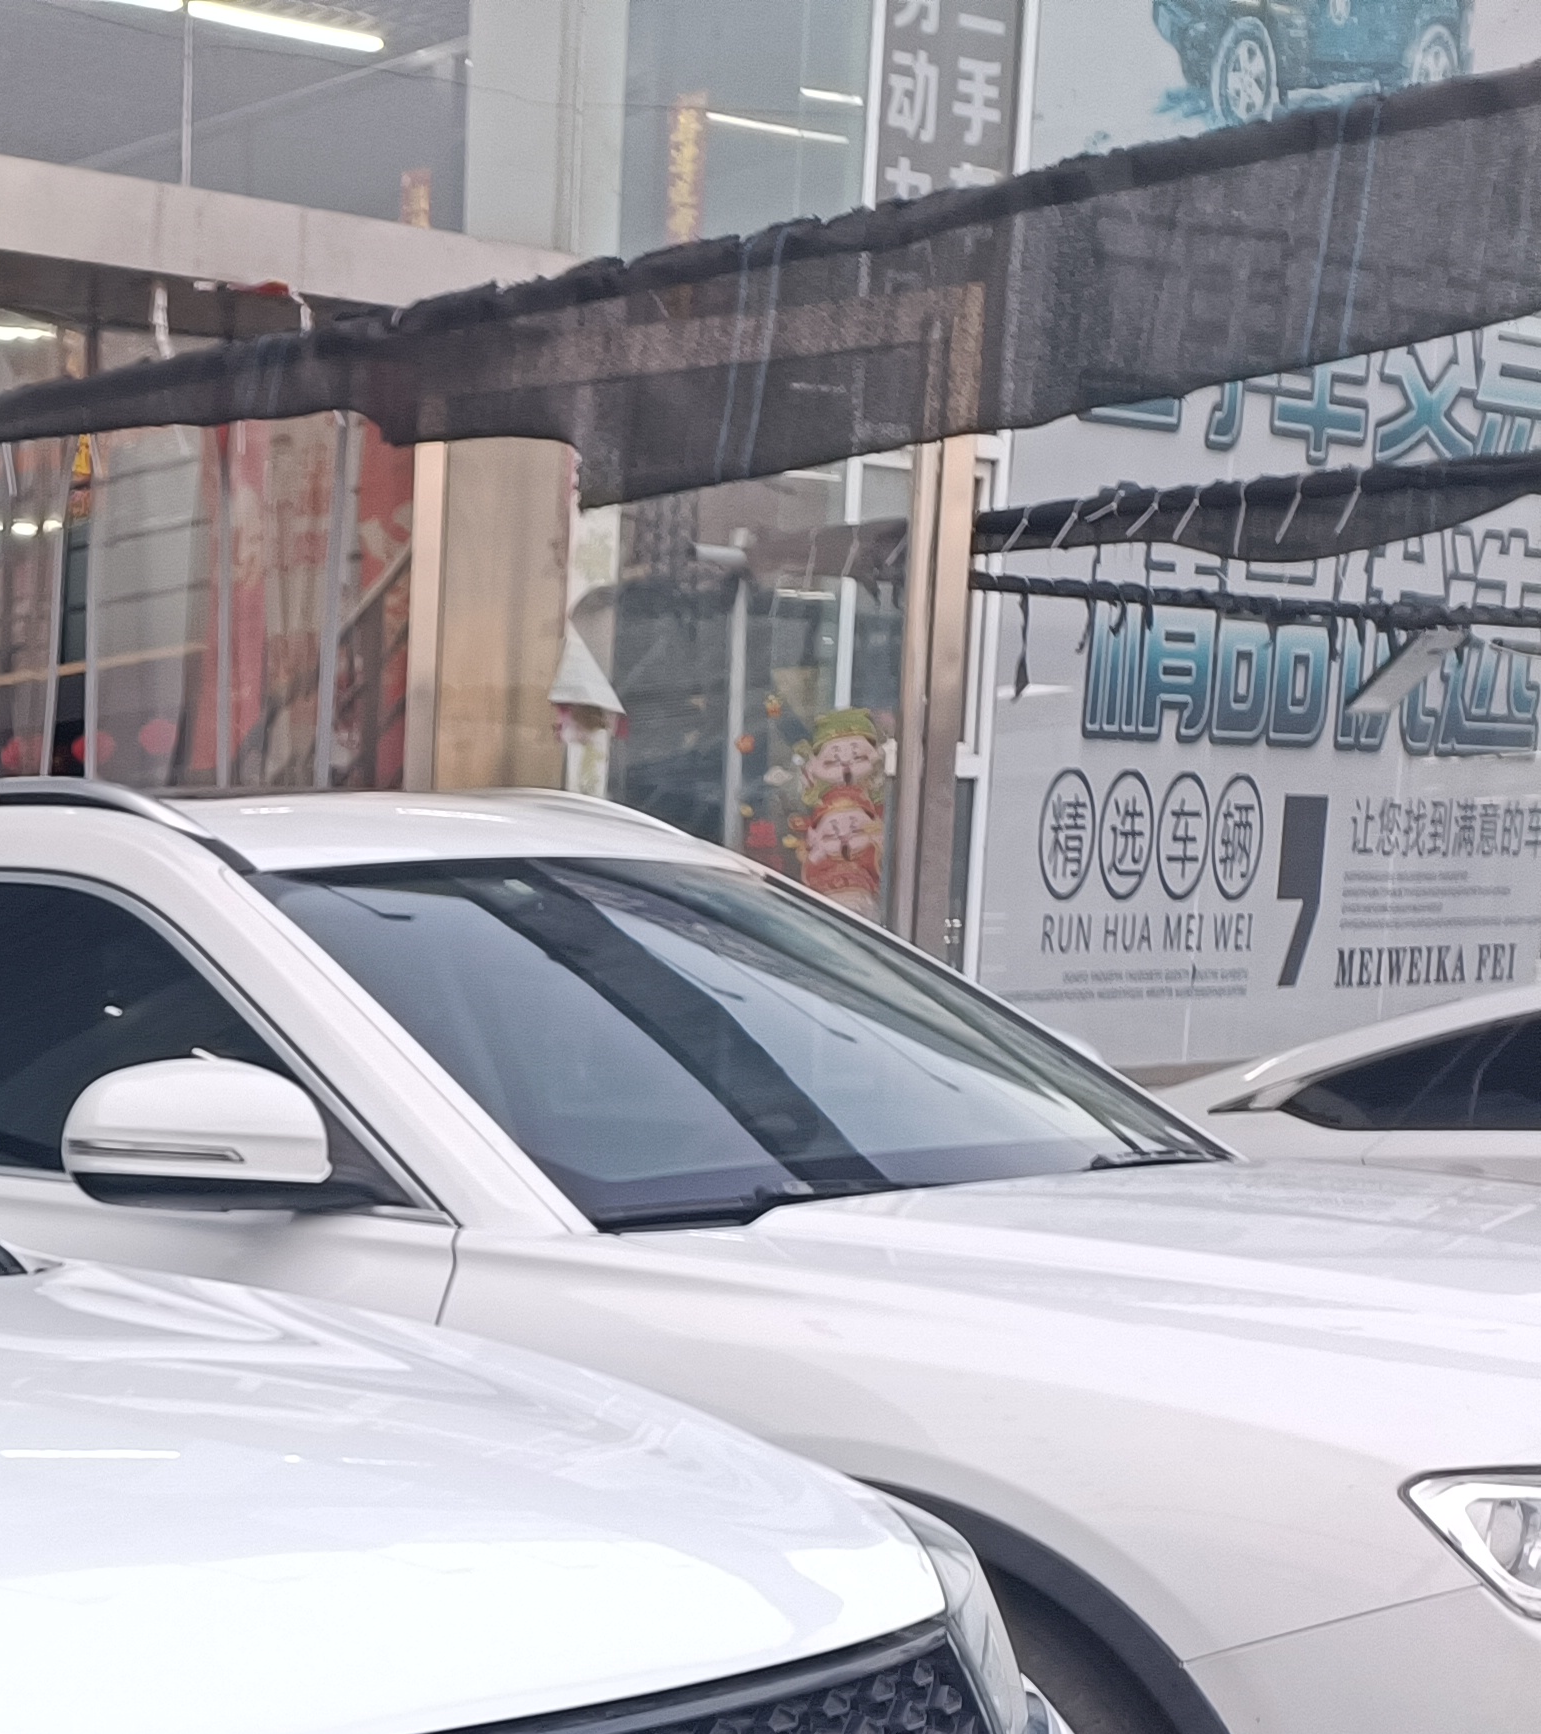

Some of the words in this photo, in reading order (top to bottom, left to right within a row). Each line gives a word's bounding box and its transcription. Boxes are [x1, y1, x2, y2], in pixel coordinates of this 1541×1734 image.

[1046, 793, 1255, 881] 精选车辆
[1040, 912, 1093, 954] RUN
[1102, 912, 1153, 954] HUA
[1162, 912, 1205, 953] MEI
[1213, 912, 1254, 953] WEI
[1334, 943, 1466, 988] MEIWEIKA
[1475, 942, 1517, 983] FEI
